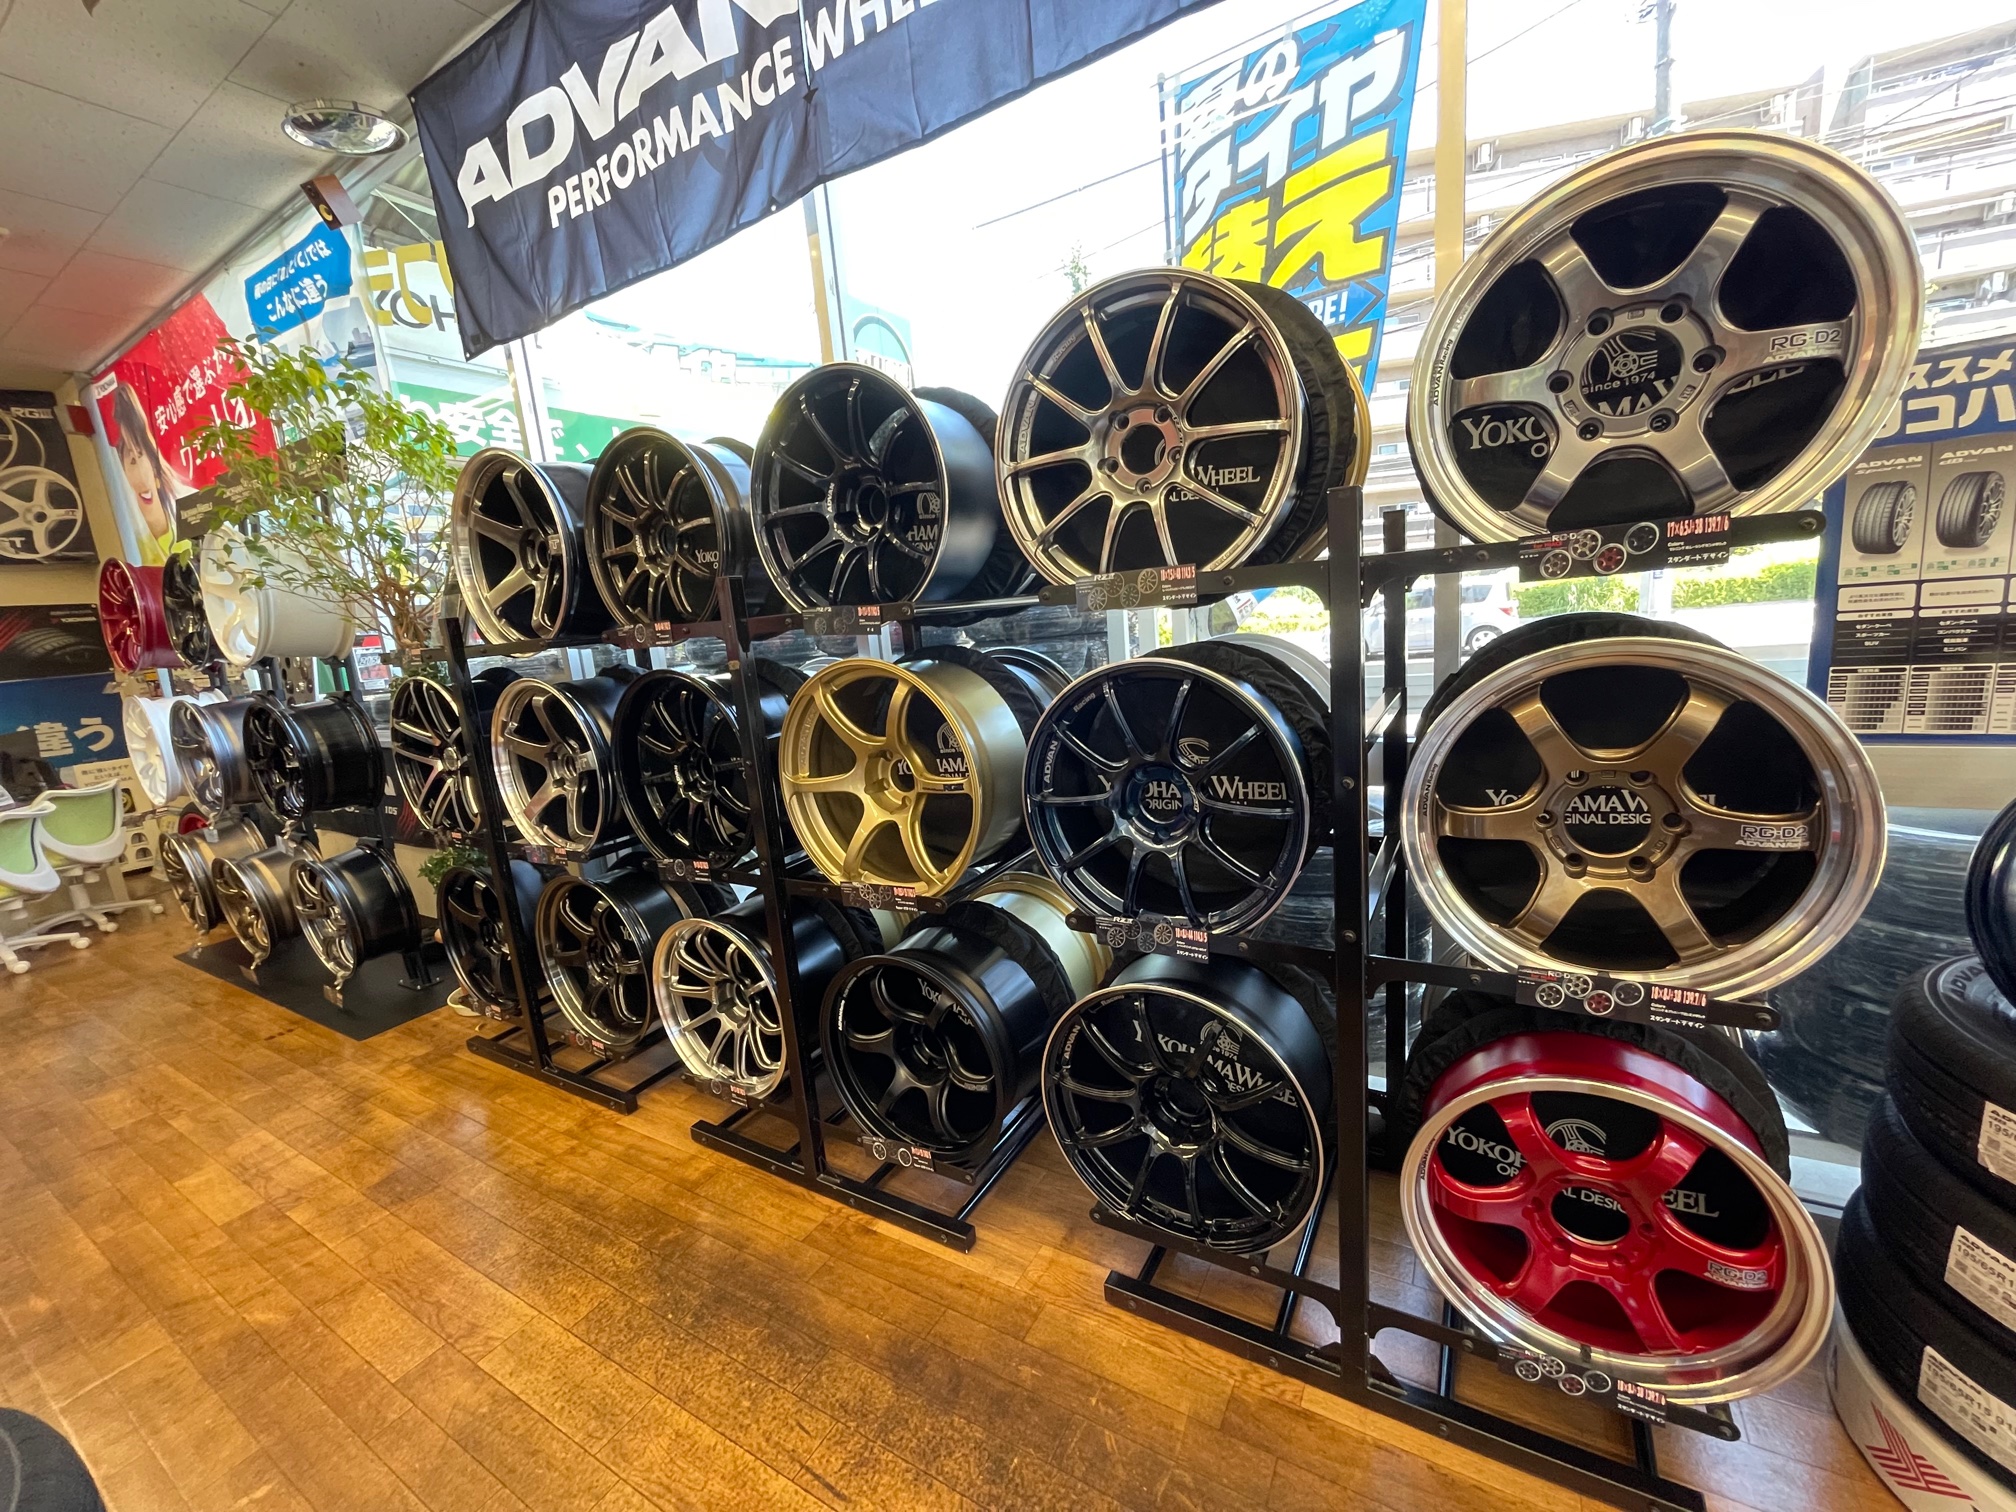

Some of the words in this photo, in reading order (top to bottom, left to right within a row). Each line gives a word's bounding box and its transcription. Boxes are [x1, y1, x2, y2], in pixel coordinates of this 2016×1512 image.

[547, 36, 796, 229] PERFORMANCE
[1183, 28, 1406, 247] タイヤ
[266, 274, 328, 322] こんなに違う
[1769, 328, 1841, 353] RG-D2
[1433, 365, 1444, 407] ADVAN
[1582, 380, 1621, 395] since
[1624, 371, 1656, 387] 1974
[1019, 399, 1037, 455] ADVAN
[1855, 455, 1923, 470] ADVAN
[1939, 444, 2014, 460] ADVAN
[1043, 740, 1058, 784] ADVAN
[1740, 824, 1809, 840] RG-D2
[1063, 1025, 1081, 1060] ADVAN
[1960, 1234, 2015, 1274] ADVAN
